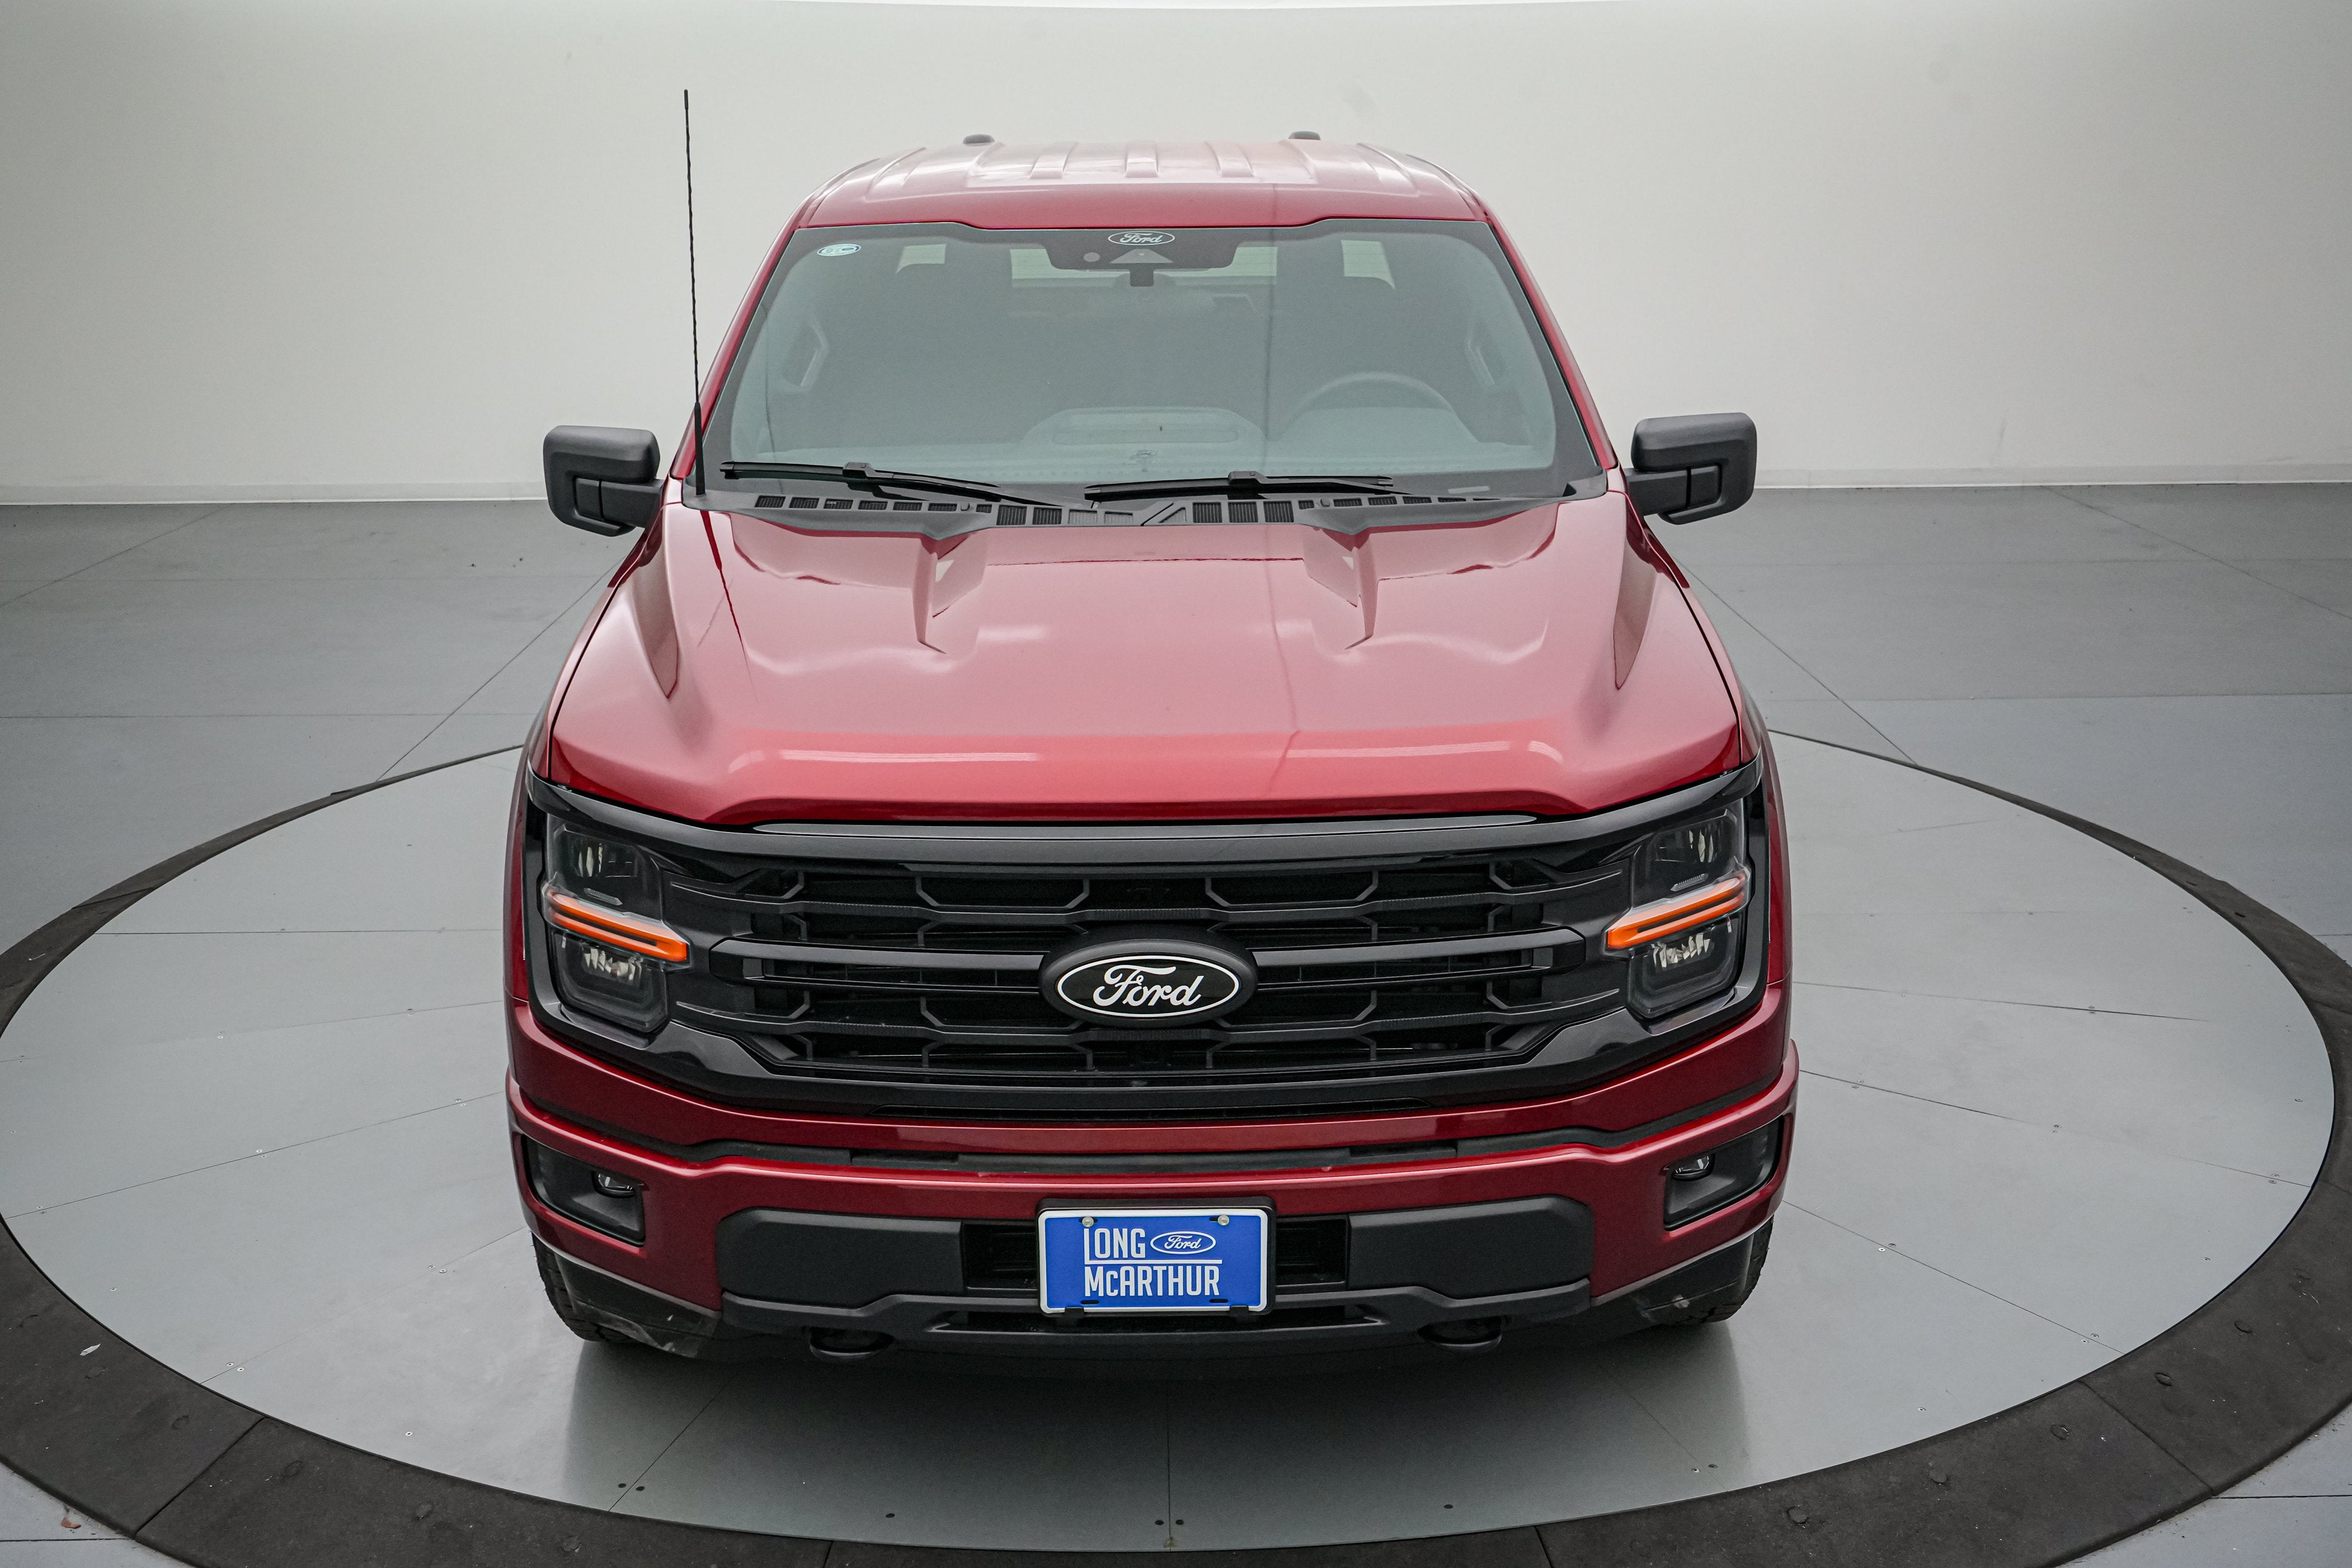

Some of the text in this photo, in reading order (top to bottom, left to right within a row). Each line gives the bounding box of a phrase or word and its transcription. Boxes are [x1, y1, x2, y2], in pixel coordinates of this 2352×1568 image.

[1120, 233, 1162, 243] Ford
[1093, 965, 1204, 1007] Ford
[1084, 1228, 1145, 1262] LONG
[1164, 1235, 1202, 1250] Ford
